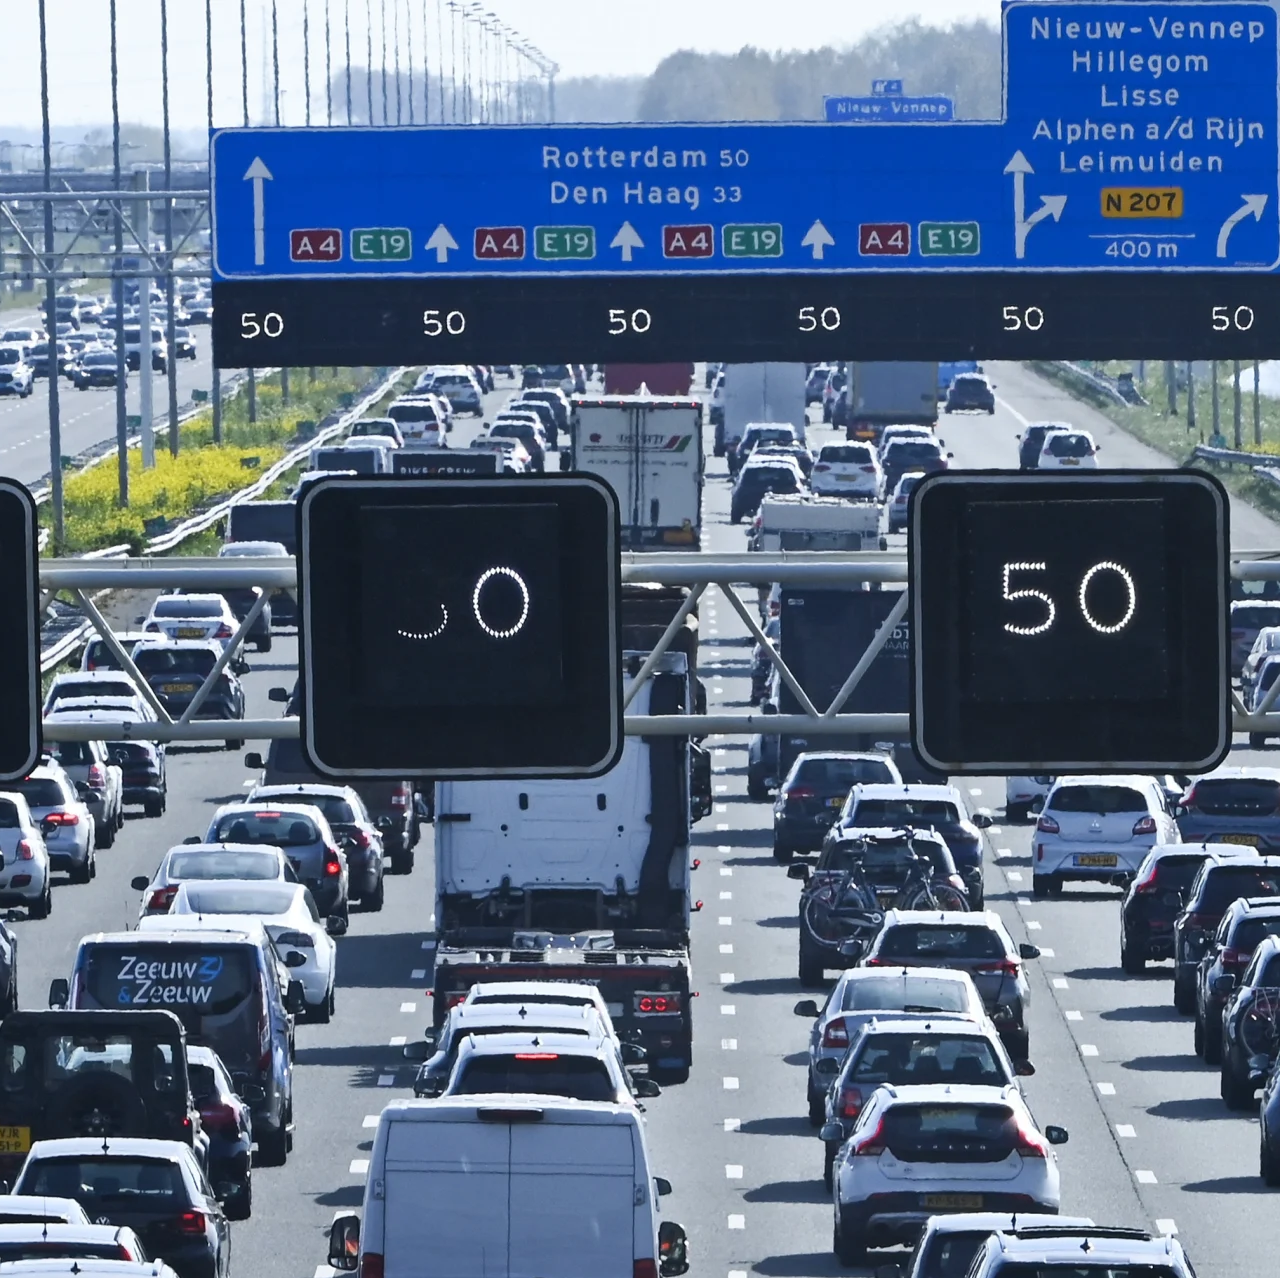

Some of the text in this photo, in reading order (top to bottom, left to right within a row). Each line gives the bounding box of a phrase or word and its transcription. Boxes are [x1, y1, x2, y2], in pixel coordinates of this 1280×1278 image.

[1030, 16, 1265, 46] Nieuw-Vennep
[1072, 49, 1209, 78] Hillegom
[1101, 83, 1179, 108] Lisse
[1032, 116, 1265, 147] Alphen a/d Rijn
[543, 146, 750, 169] Rotterdam 50
[1060, 150, 1223, 174] Leimuiden
[551, 182, 743, 209] Den Haag 33
[1105, 241, 1178, 258] 400 m
[241, 313, 284, 339] 50
[424, 310, 466, 336] 50
[608, 309, 651, 334] 50
[799, 307, 840, 331] 50
[1003, 306, 1044, 331] 50
[1212, 306, 1254, 331] 50
[1003, 560, 1137, 636] 50
[117, 956, 197, 981] Zeeuw
